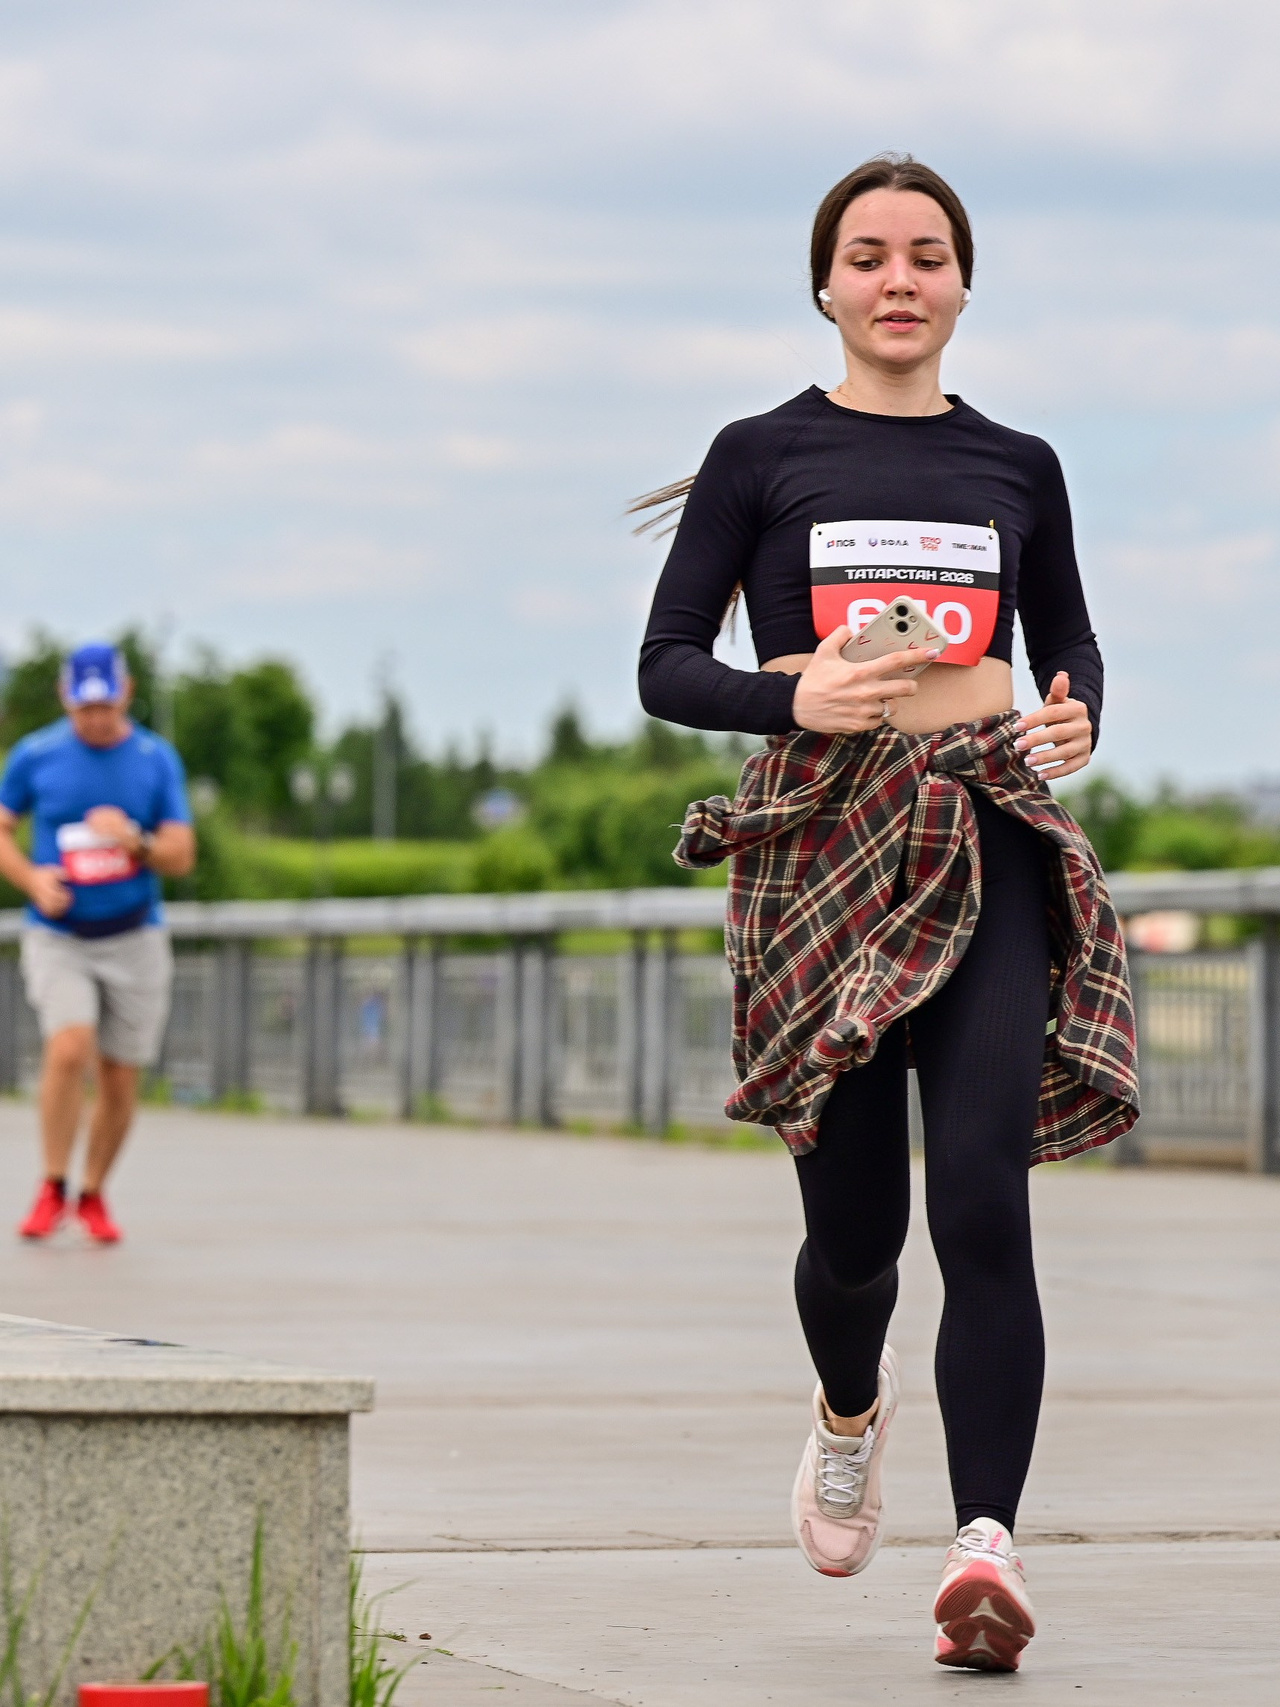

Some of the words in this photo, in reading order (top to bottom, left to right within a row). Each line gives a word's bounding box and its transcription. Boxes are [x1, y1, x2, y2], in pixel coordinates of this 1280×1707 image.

[836, 538, 856, 548] ПСБ
[844, 568, 938, 581] ТАТАРСТАН
[939, 571, 975, 584] 2026
[847, 598, 973, 645] 60
